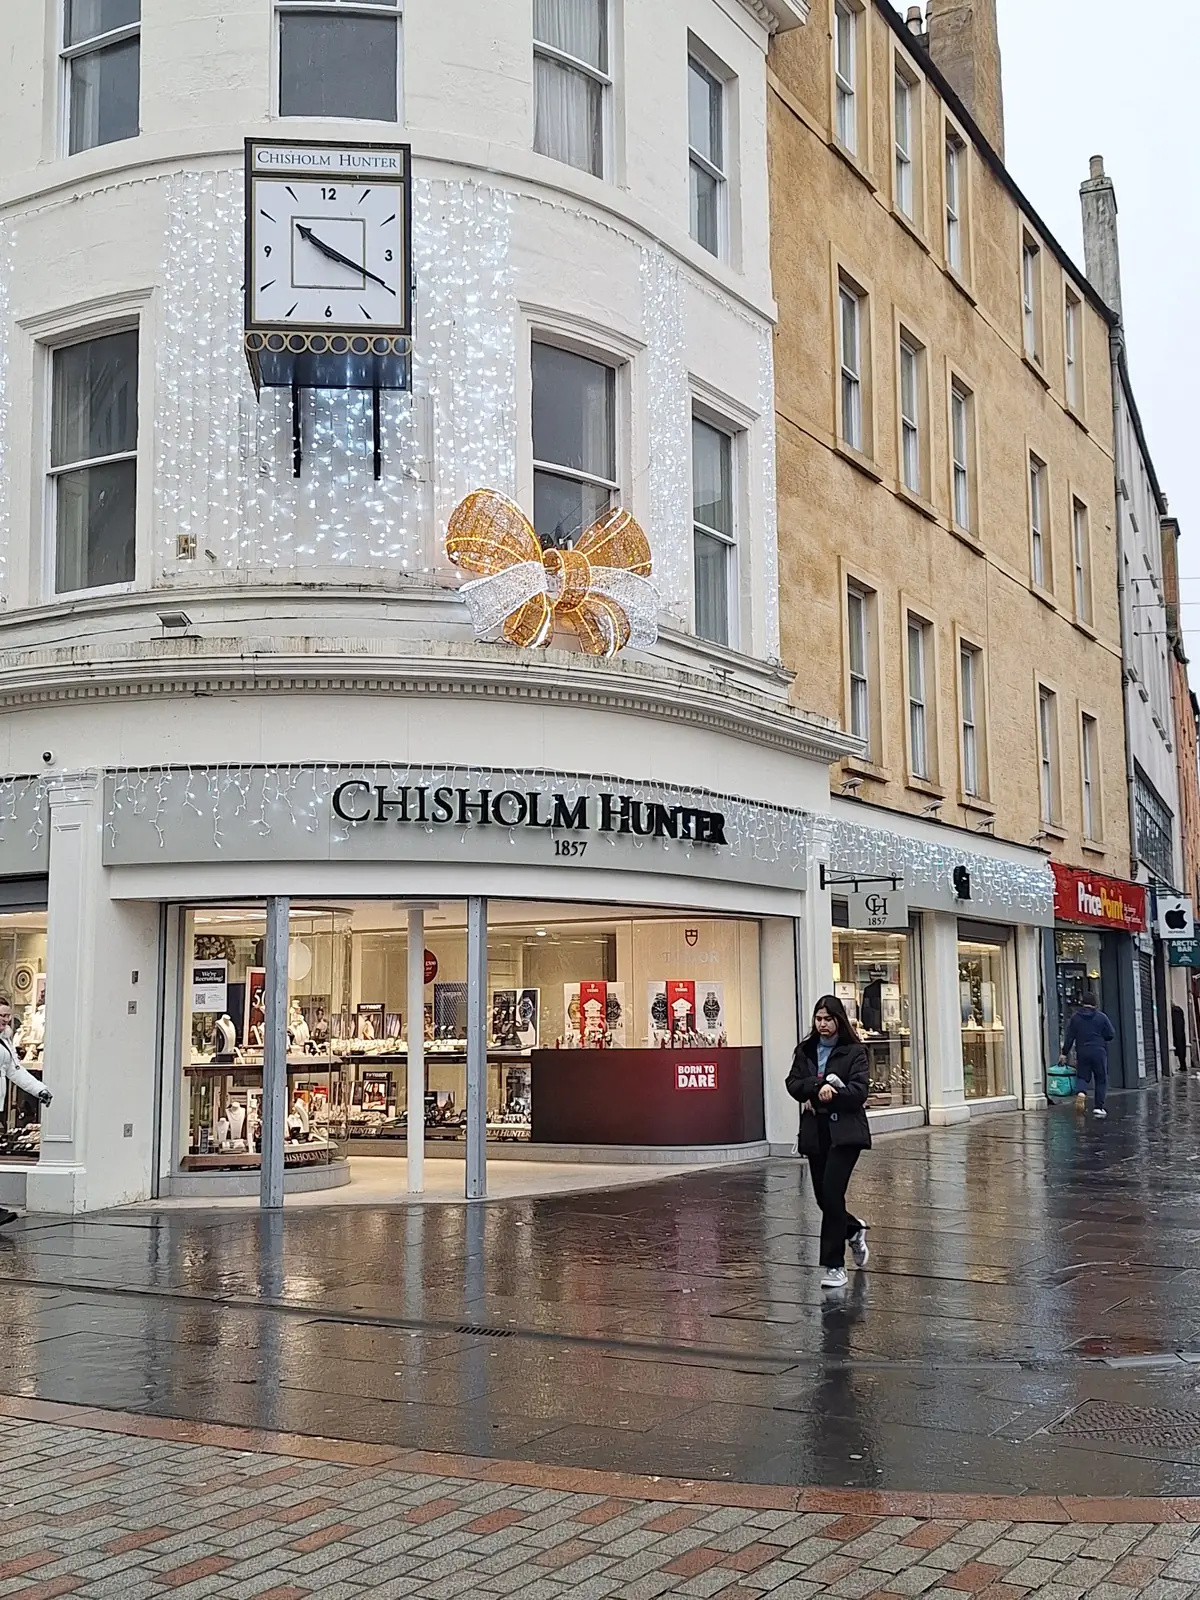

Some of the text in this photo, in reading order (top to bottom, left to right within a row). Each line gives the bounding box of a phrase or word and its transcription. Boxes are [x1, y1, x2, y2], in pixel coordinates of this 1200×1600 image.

[257, 151, 397, 168] CHISHOLM HUNTER
[320, 188, 337, 200] 12
[264, 245, 272, 258] 9
[384, 250, 393, 262] 3
[324, 305, 333, 318] 6
[331, 780, 728, 845] CHISHOLM HUNTER
[554, 840, 587, 857] 1857
[1077, 881, 1124, 921] PricePoint
[868, 917, 887, 926] 1857
[677, 1065, 715, 1074] BORN TO
[677, 1074, 716, 1088] DARE
